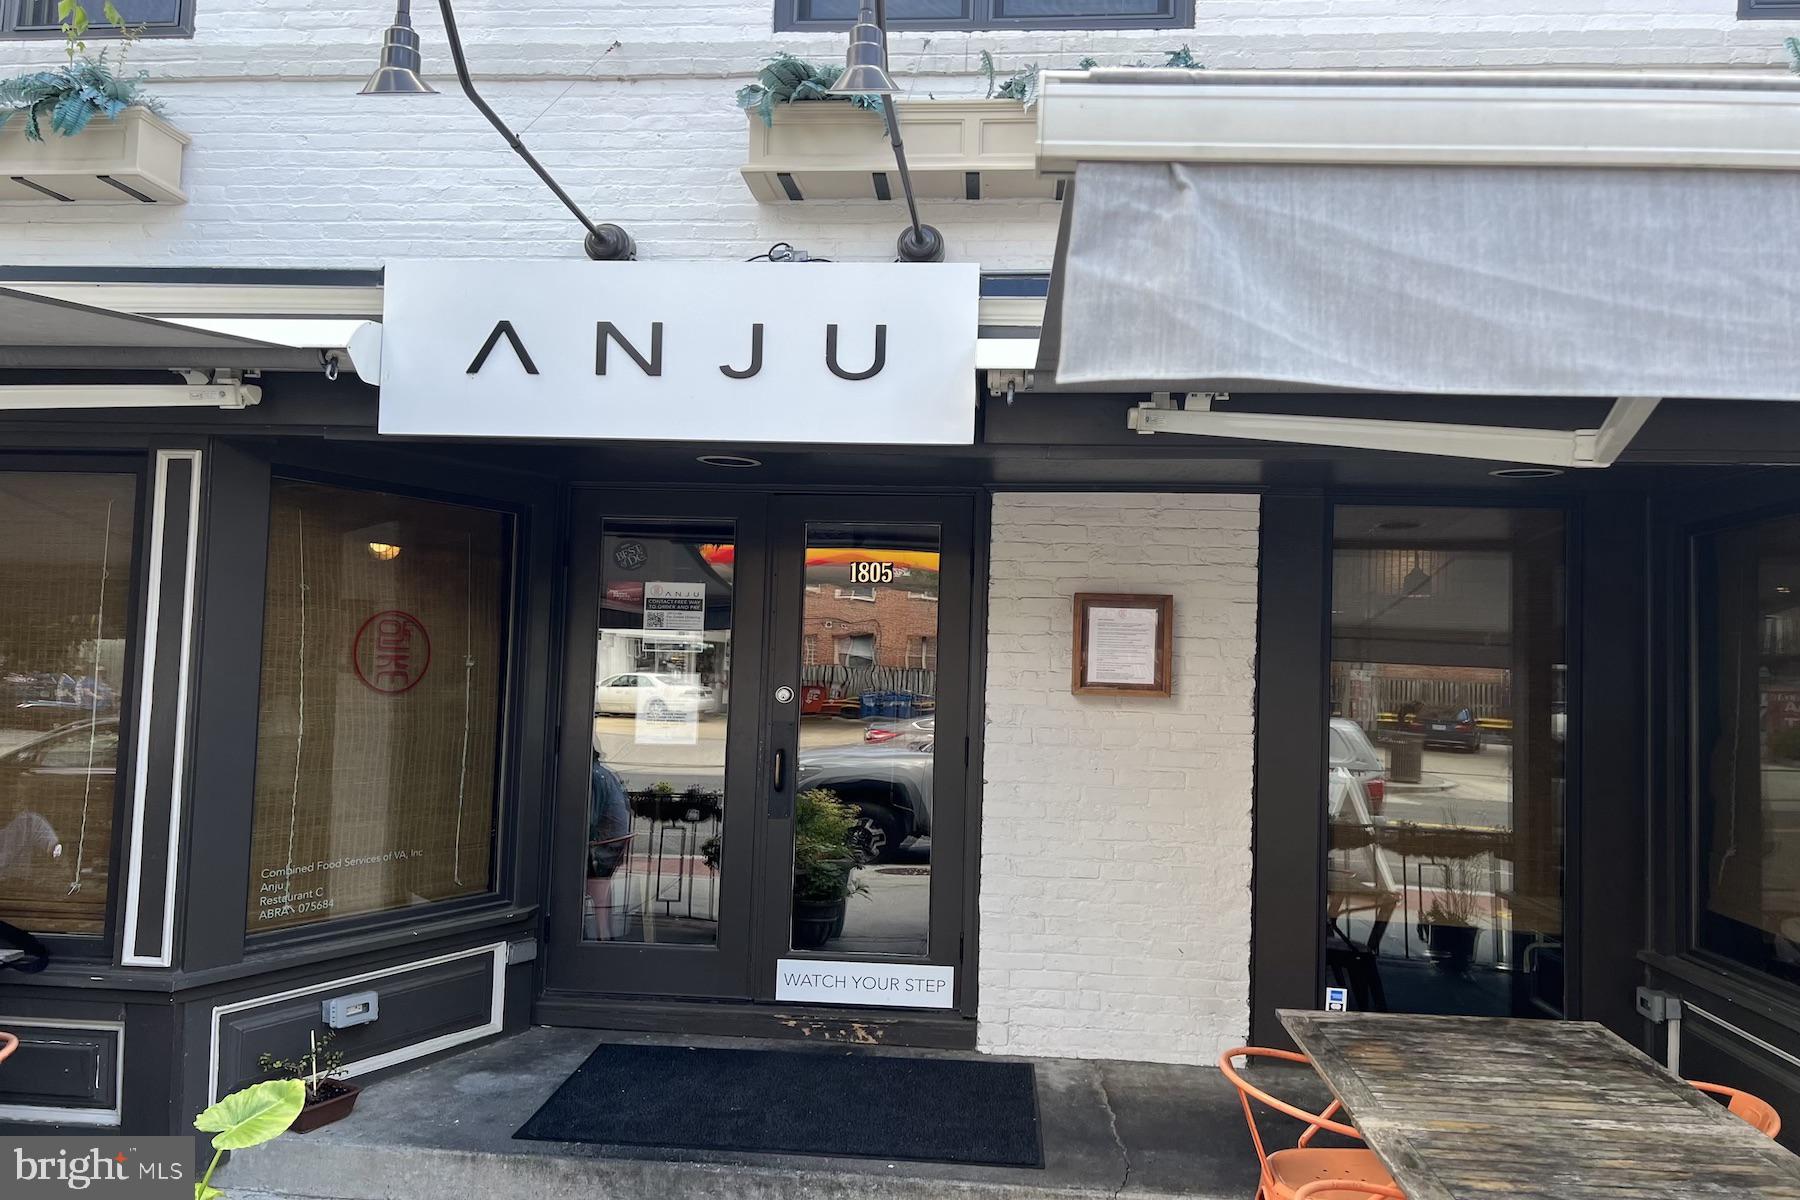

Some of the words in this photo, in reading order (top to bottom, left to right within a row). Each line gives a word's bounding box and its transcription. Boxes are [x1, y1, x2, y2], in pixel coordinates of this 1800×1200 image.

[466, 320, 887, 381] ANJU
[850, 562, 893, 583] 1805
[665, 591, 700, 599] ANJU
[261, 863, 315, 880] Combined
[317, 858, 342, 871] Food
[344, 855, 381, 868] Services
[383, 852, 393, 862] of
[259, 890, 313, 907] Restaurant
[315, 887, 324, 898] C
[260, 882, 284, 895] Anju
[298, 898, 335, 914] 075684
[784, 973, 846, 989] WATCH
[852, 976, 899, 991] YOUR
[905, 979, 946, 993] STEP
